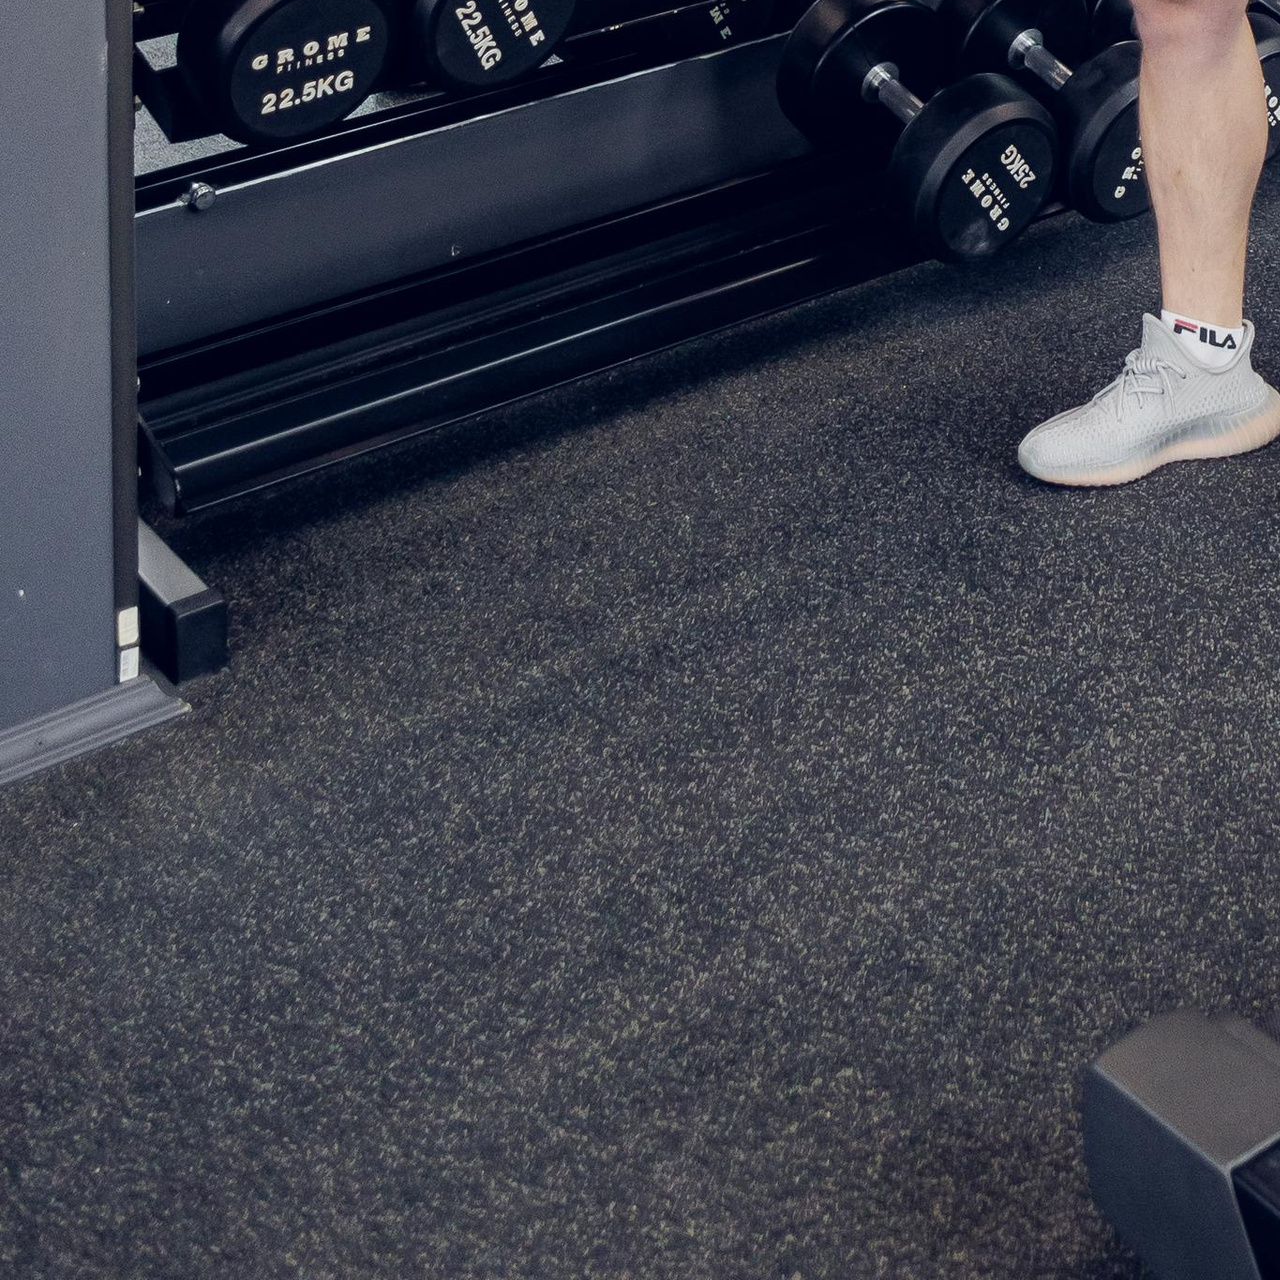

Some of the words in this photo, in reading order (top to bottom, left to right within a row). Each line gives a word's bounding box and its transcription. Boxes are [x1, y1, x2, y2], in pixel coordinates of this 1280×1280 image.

[252, 26, 371, 70] GROME
[455, 0, 502, 71] 22.5KG
[261, 70, 354, 115] 22.5KG
[1000, 144, 1037, 189] 25KG
[1114, 147, 1142, 199] GRO
[961, 168, 1010, 231] GROME
[1173, 319, 1237, 349] FILA
